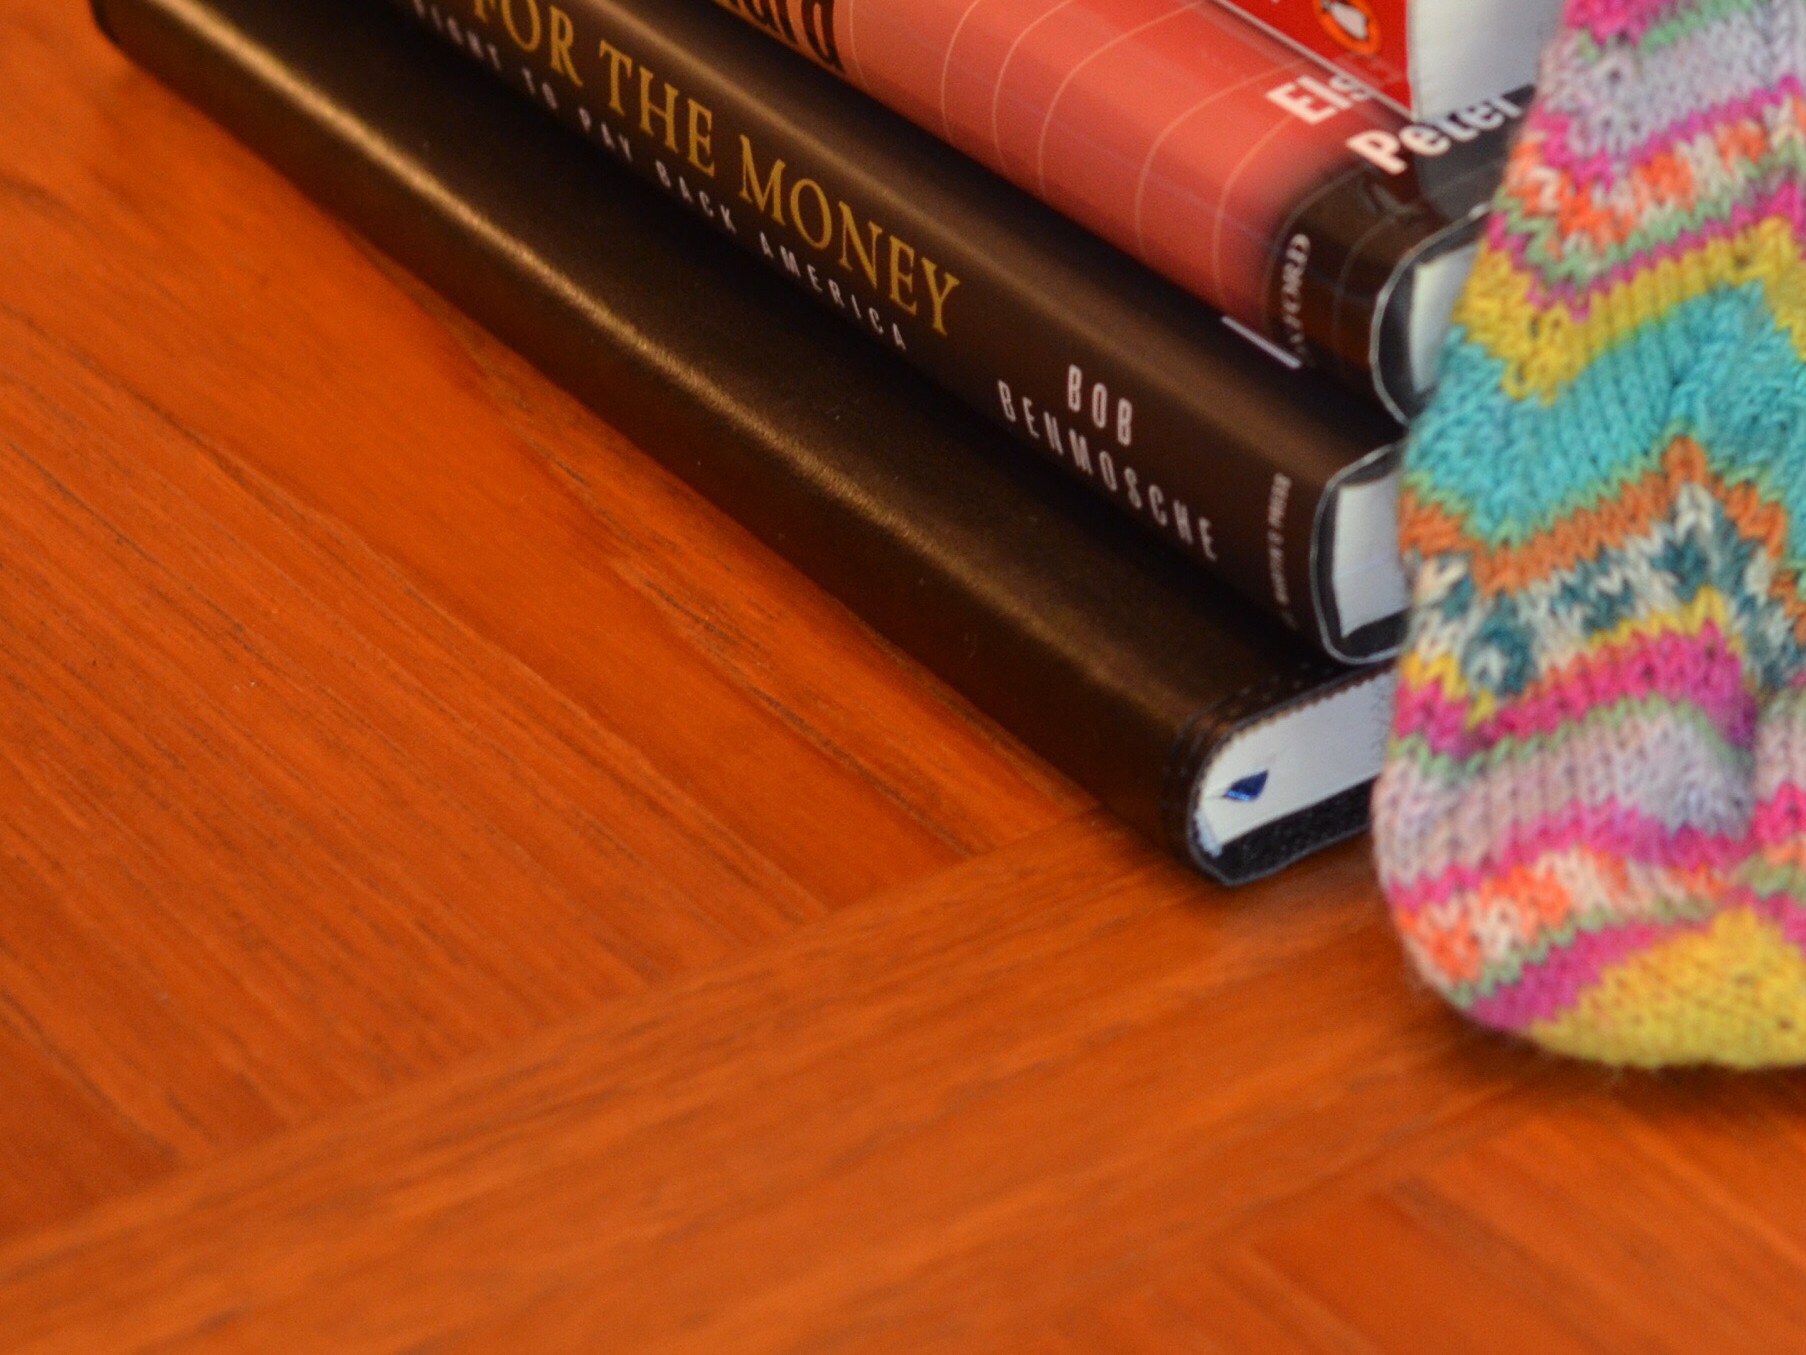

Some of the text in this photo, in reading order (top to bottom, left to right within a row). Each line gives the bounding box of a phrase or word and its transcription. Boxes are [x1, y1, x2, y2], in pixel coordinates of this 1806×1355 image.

[600, 39, 716, 178] THE
[738, 133, 961, 337] MONEY
[655, 158, 738, 235] BACK
[759, 230, 908, 352] AMERICA
[997, 379, 1219, 562] BENMOSCHE
[1067, 363, 1133, 447] BOB
